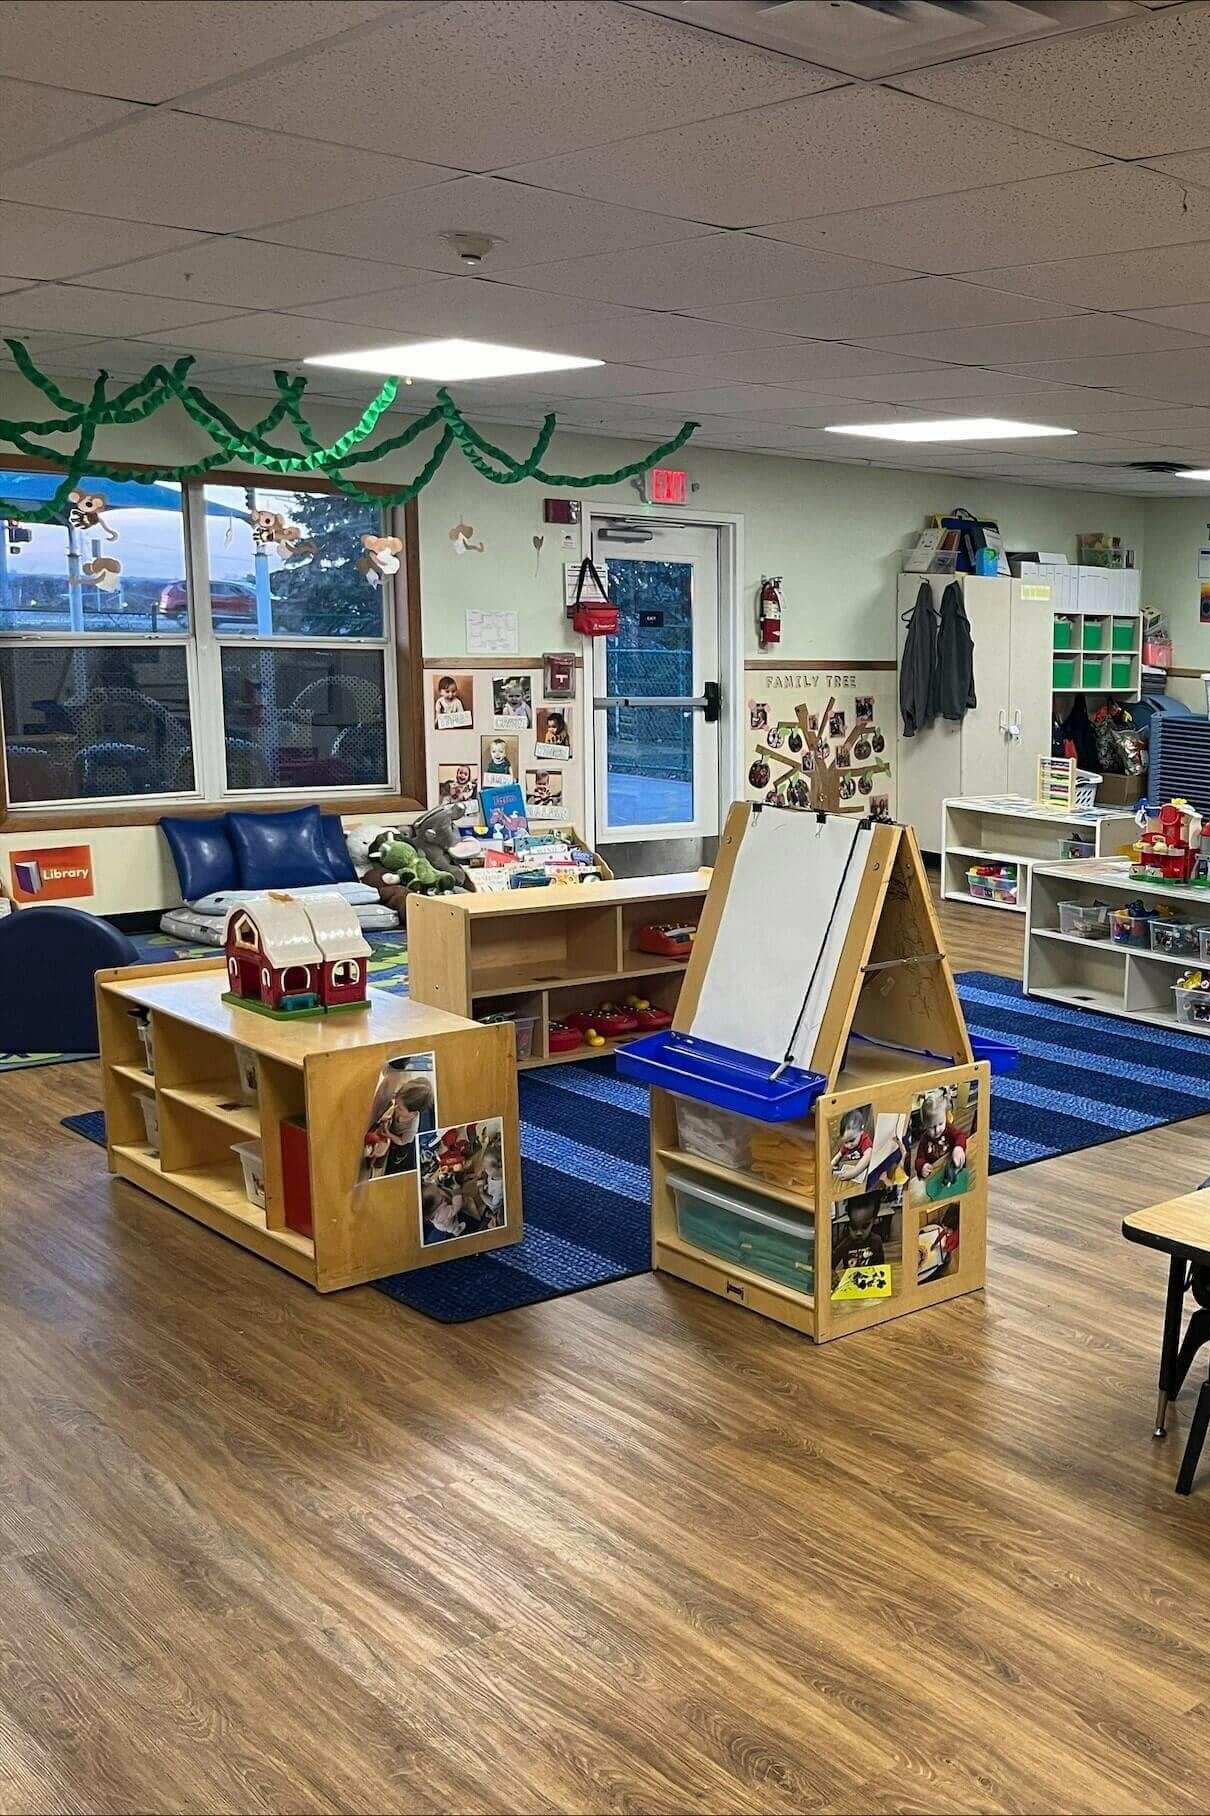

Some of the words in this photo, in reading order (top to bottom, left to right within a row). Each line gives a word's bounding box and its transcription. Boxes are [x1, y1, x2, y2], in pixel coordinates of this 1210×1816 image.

[653, 469, 686, 503] EXIT
[766, 675, 819, 688] FAMILY
[826, 675, 857, 688] TREE
[43, 868, 89, 881] Library
